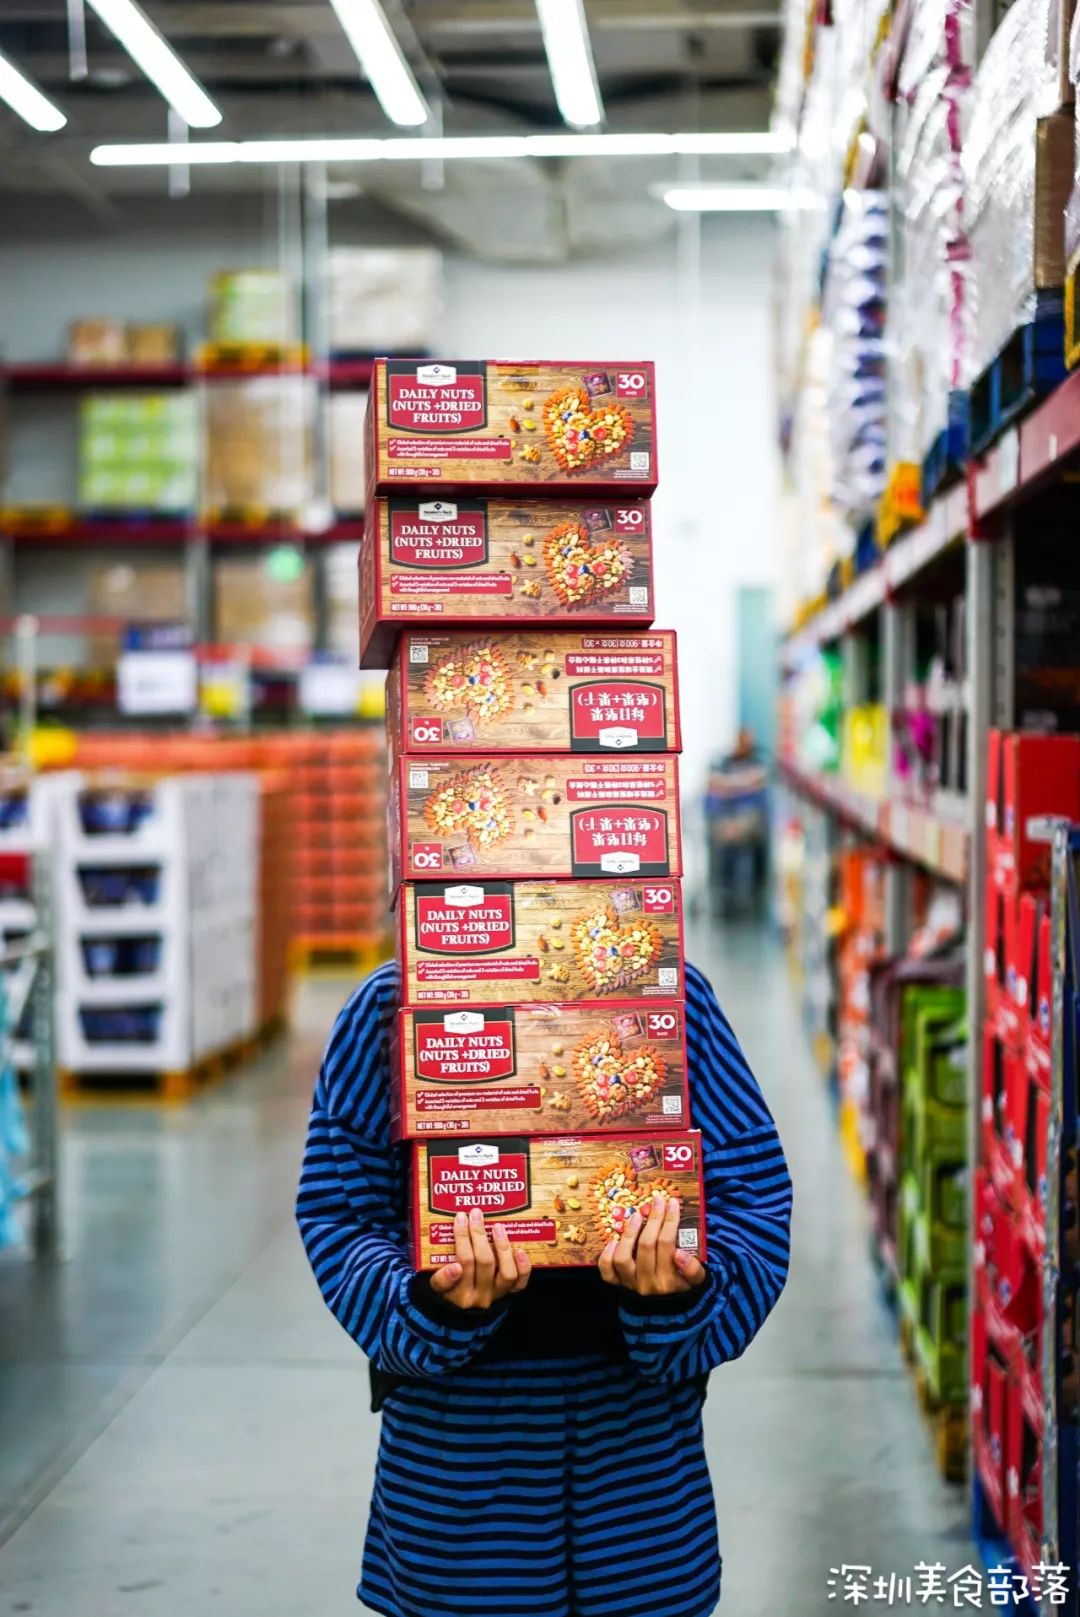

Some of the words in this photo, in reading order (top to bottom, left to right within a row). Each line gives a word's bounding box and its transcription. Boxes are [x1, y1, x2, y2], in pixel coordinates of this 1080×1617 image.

[618, 374, 645, 389] 30
[399, 388, 438, 399] DAILY
[440, 389, 475, 400] NUTS
[392, 399, 432, 412] (NUTS
[433, 400, 482, 412] +DRIED
[413, 412, 462, 424] FRUITS)
[616, 510, 643, 525] 30
[401, 525, 440, 535] DAILY
[442, 525, 476, 536] NUTS
[394, 536, 434, 548] (NUTS
[435, 537, 483, 547] +DRIED
[415, 548, 464, 560] FRUITS)
[577, 691, 658, 707] （坚果+果干）
[591, 707, 645, 722] 每日坚果
[413, 726, 441, 742] 30
[578, 817, 660, 832] （坚果+果干）
[591, 831, 647, 847] 每日坚果
[413, 852, 441, 868] 30
[644, 888, 672, 904] 30
[427, 909, 466, 921] DAILY
[468, 908, 503, 920] NUTS
[420, 922, 460, 934] (NUTS
[462, 921, 510, 932] +DRIED
[441, 933, 490, 945] FRUITS)
[648, 1014, 676, 1030] 30
[426, 1037, 467, 1049] DAILY
[468, 1035, 504, 1048] NUTS
[420, 1049, 460, 1062] (NUTS
[461, 1048, 511, 1060] +DRIED
[440, 1060, 491, 1074] FRUITS)
[664, 1145, 692, 1162] 30
[440, 1169, 481, 1182] DAILY
[483, 1168, 518, 1180] NUTS
[433, 1182, 474, 1195] (NUTS
[476, 1181, 525, 1193] +DRIED
[455, 1193, 505, 1206] FRUITS)
